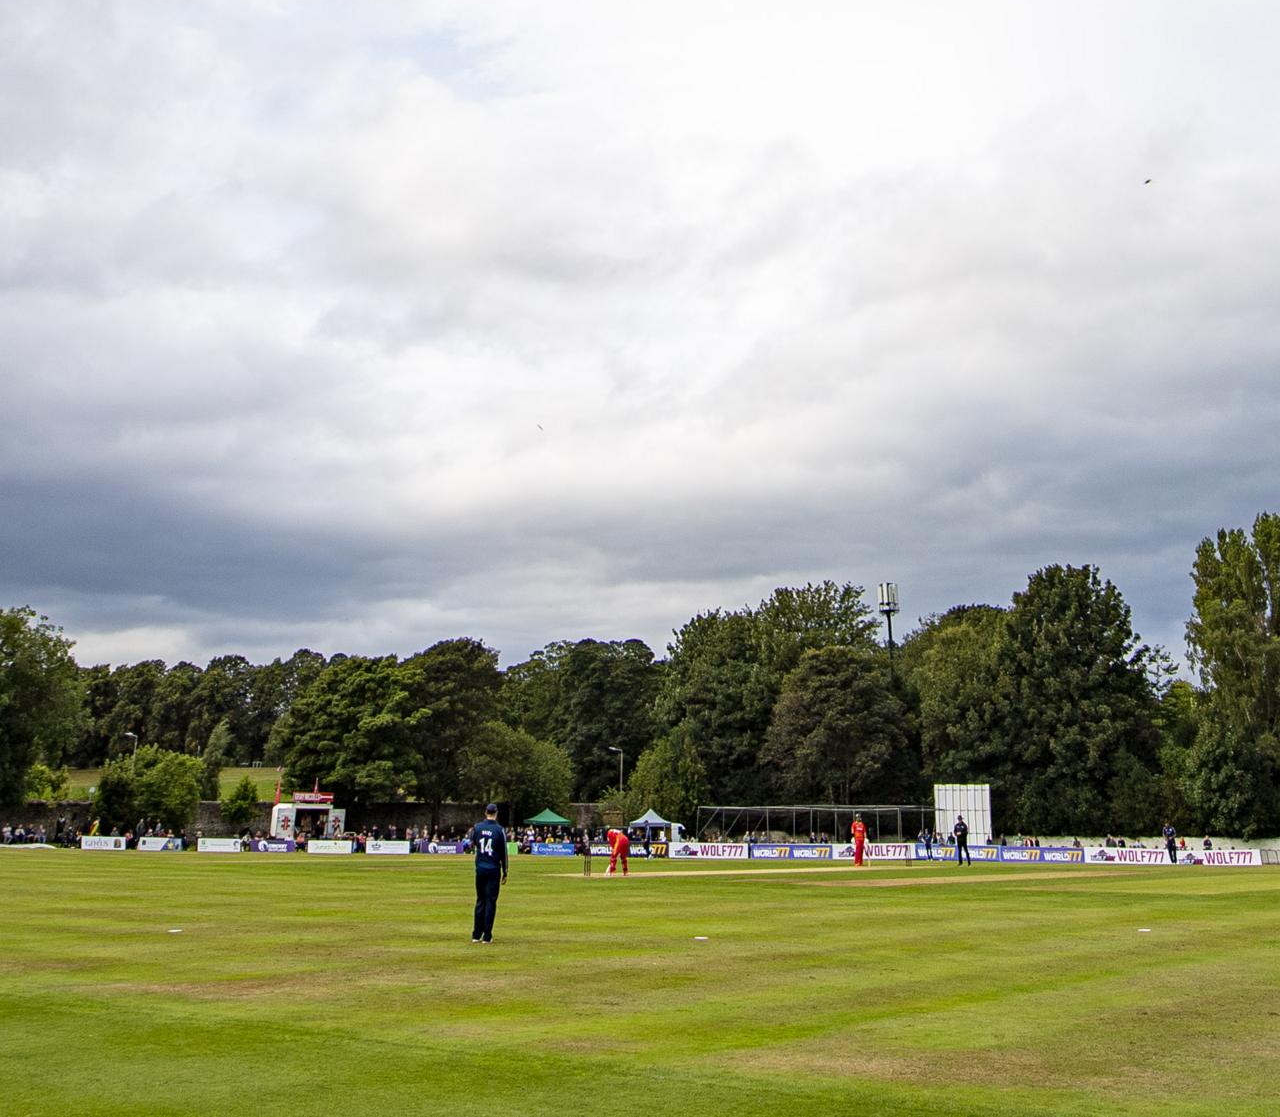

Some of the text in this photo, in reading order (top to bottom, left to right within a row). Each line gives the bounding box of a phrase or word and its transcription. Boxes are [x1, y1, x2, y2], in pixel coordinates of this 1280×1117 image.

[479, 837, 494, 856] 14
[700, 845, 744, 857] WOLF777
[753, 847, 790, 858] WORLD777
[793, 847, 831, 858] WORLD777
[864, 845, 910, 858] WOLF777
[1002, 849, 1041, 860] WORLD777
[1043, 850, 1082, 861] WORLD777
[1116, 850, 1165, 863] WOLF777
[1204, 852, 1253, 865] WOLF777
